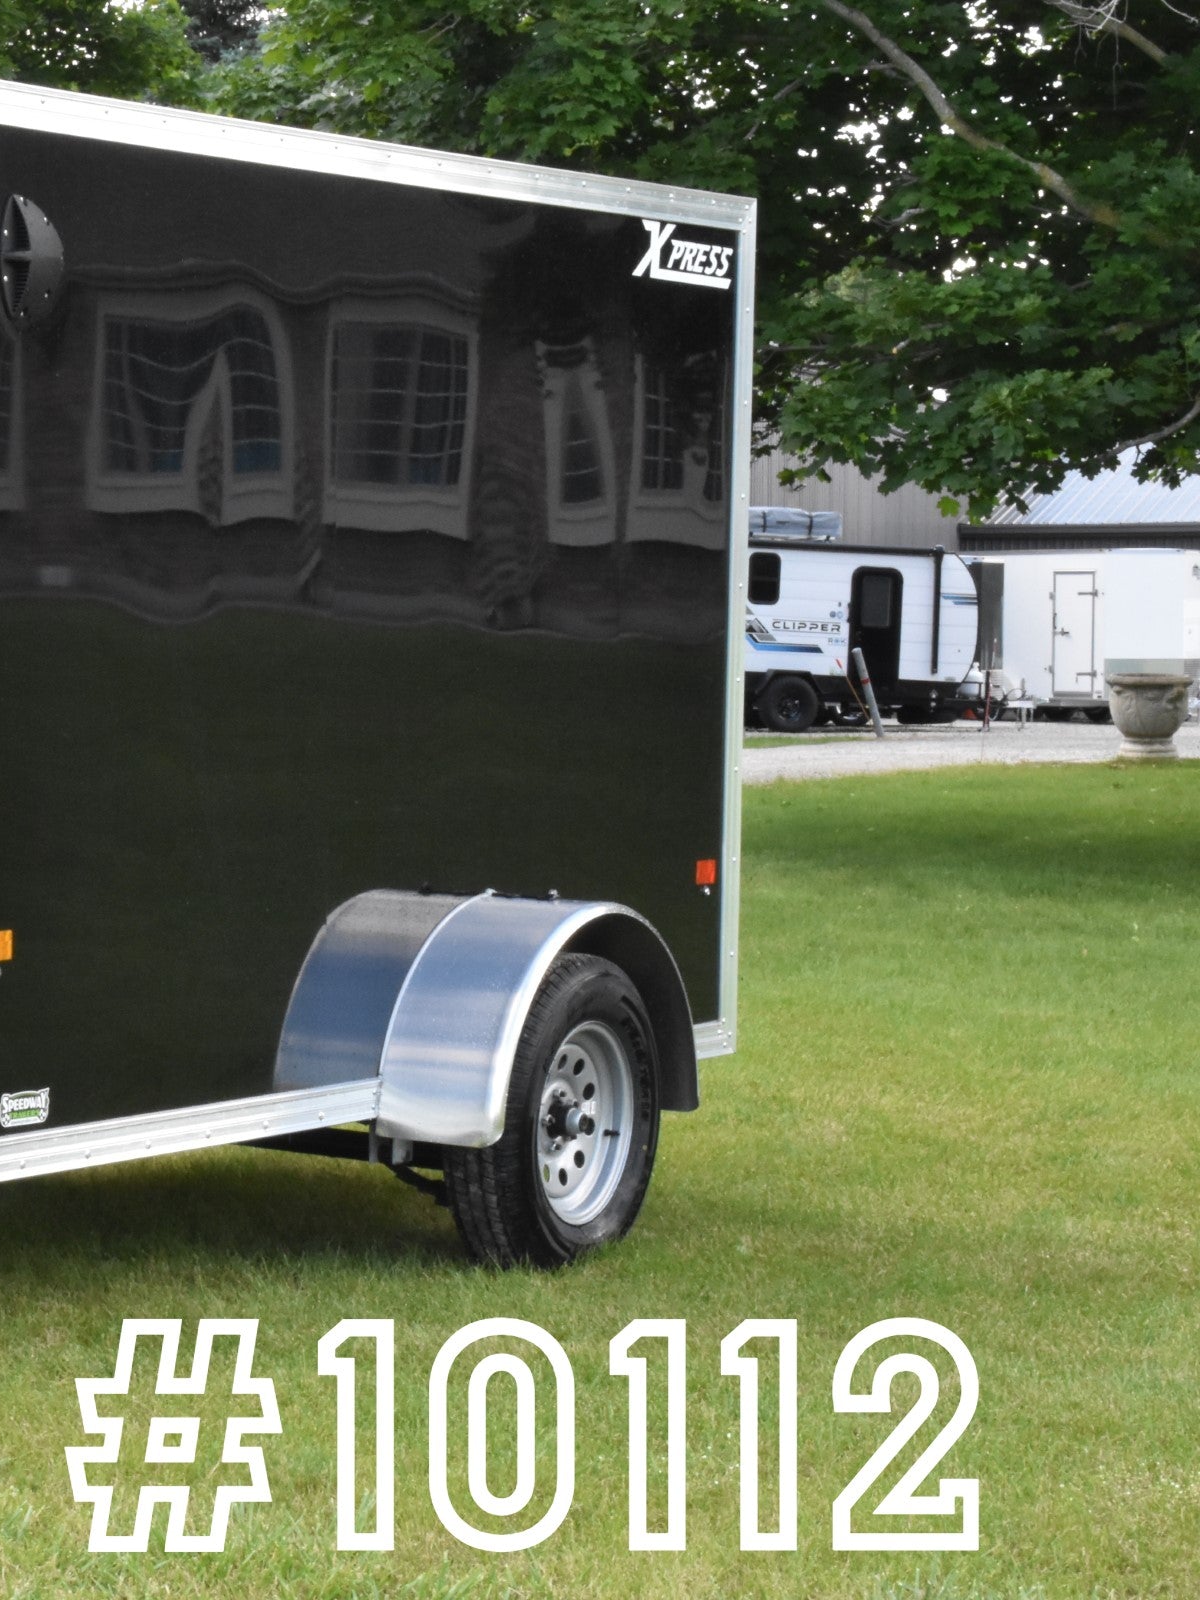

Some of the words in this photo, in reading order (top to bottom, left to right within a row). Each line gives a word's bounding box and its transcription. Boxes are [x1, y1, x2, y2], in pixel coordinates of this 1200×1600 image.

[632, 219, 734, 282] XPRESS
[772, 620, 841, 632] CLIPPER
[2, 1093, 46, 1114] SPEEDWAY
